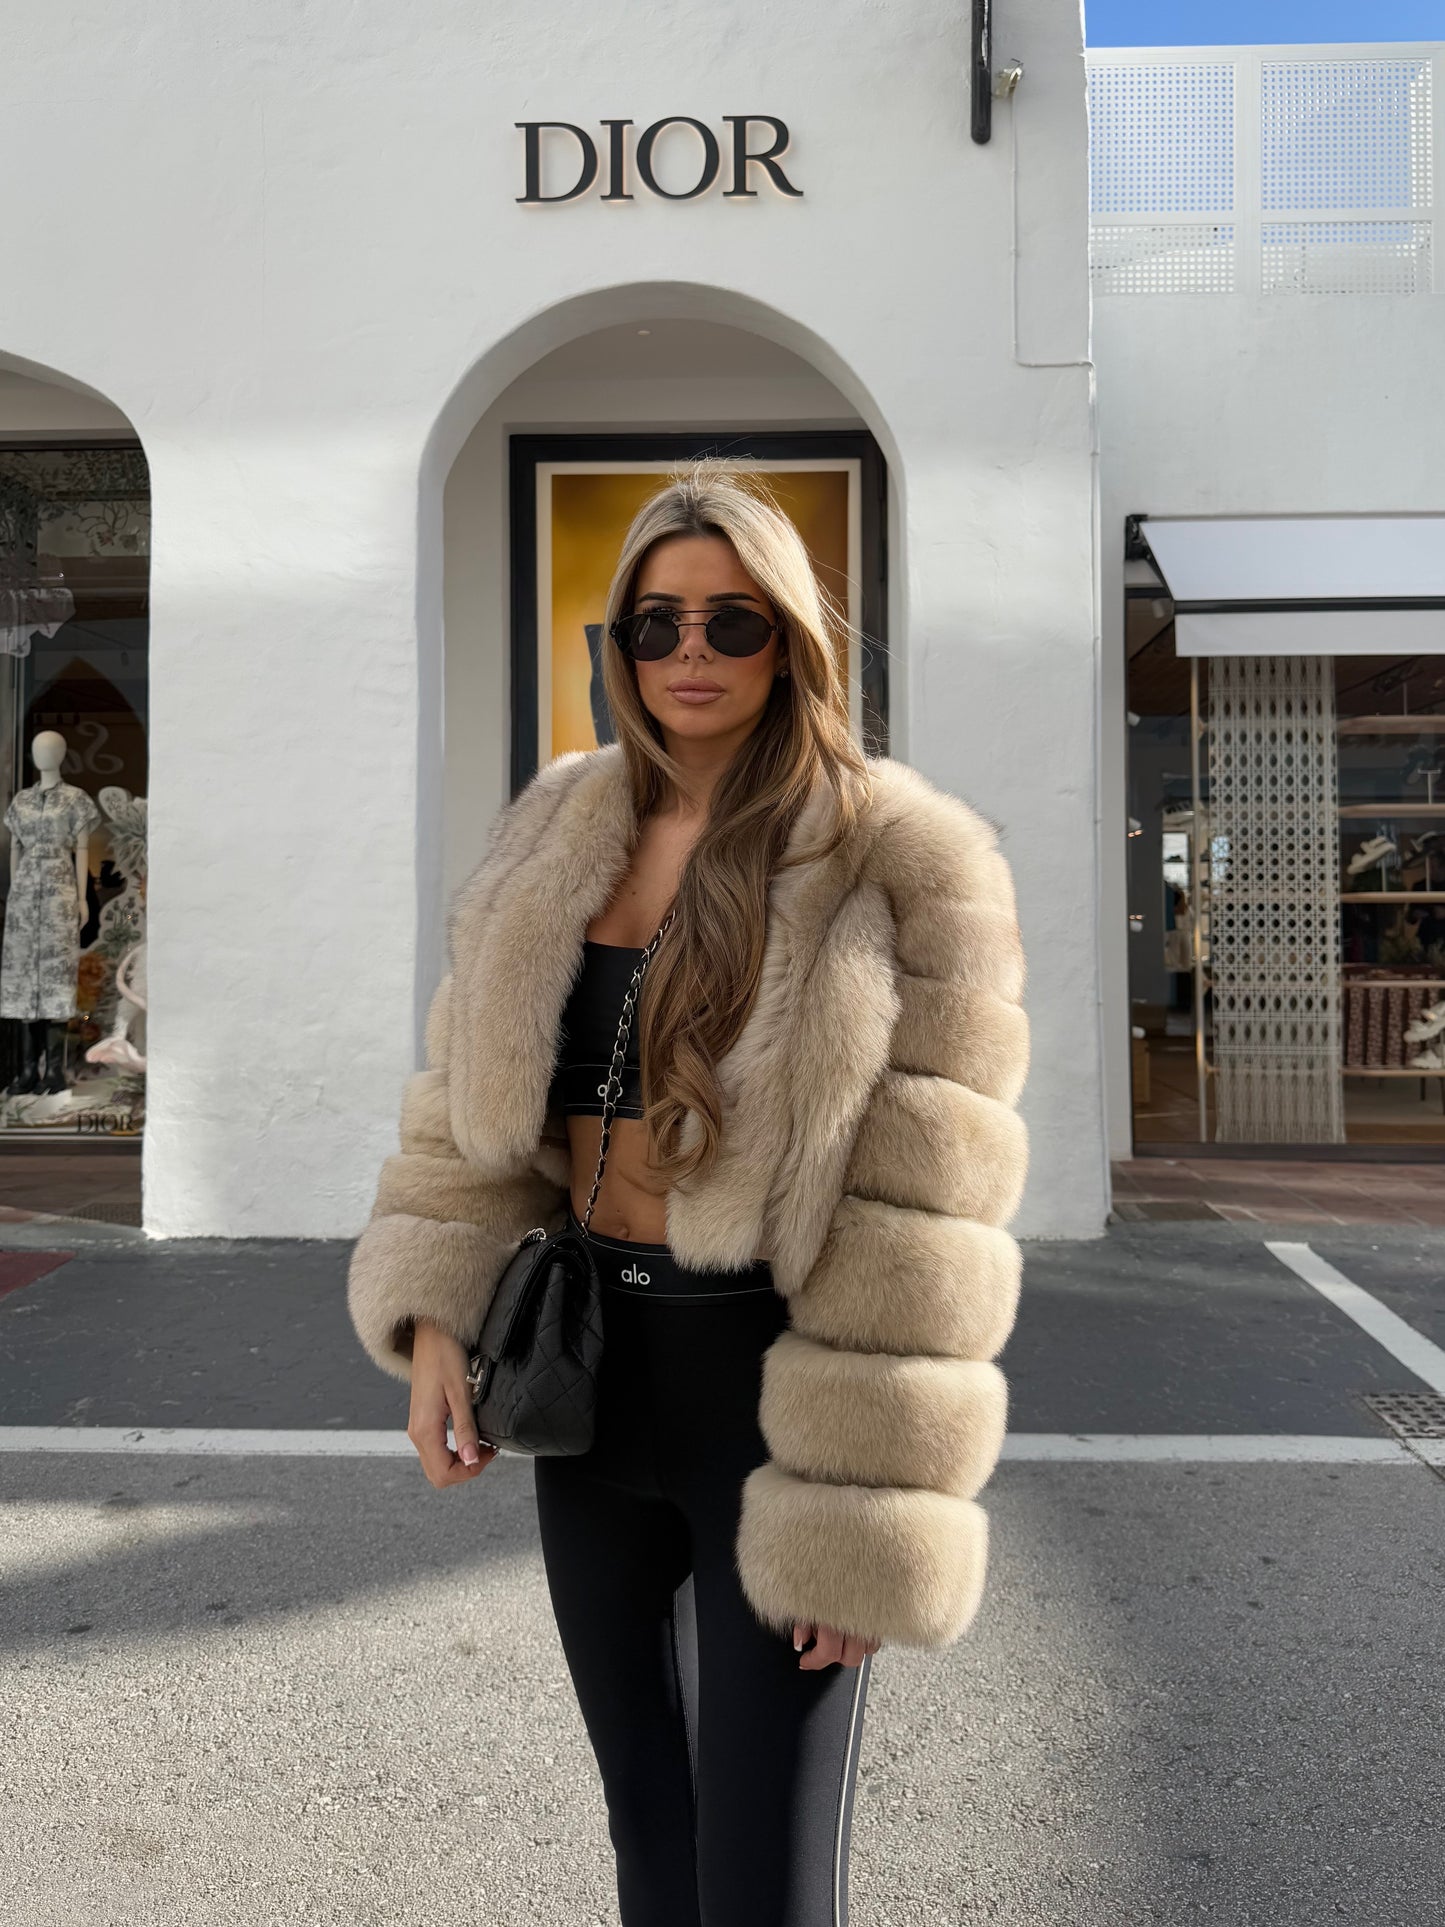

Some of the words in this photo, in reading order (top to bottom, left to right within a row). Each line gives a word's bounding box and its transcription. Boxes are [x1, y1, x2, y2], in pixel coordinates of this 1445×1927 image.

[514, 115, 804, 203] DIOR
[77, 1113, 135, 1132] DIOR
[621, 1263, 650, 1285] alo
